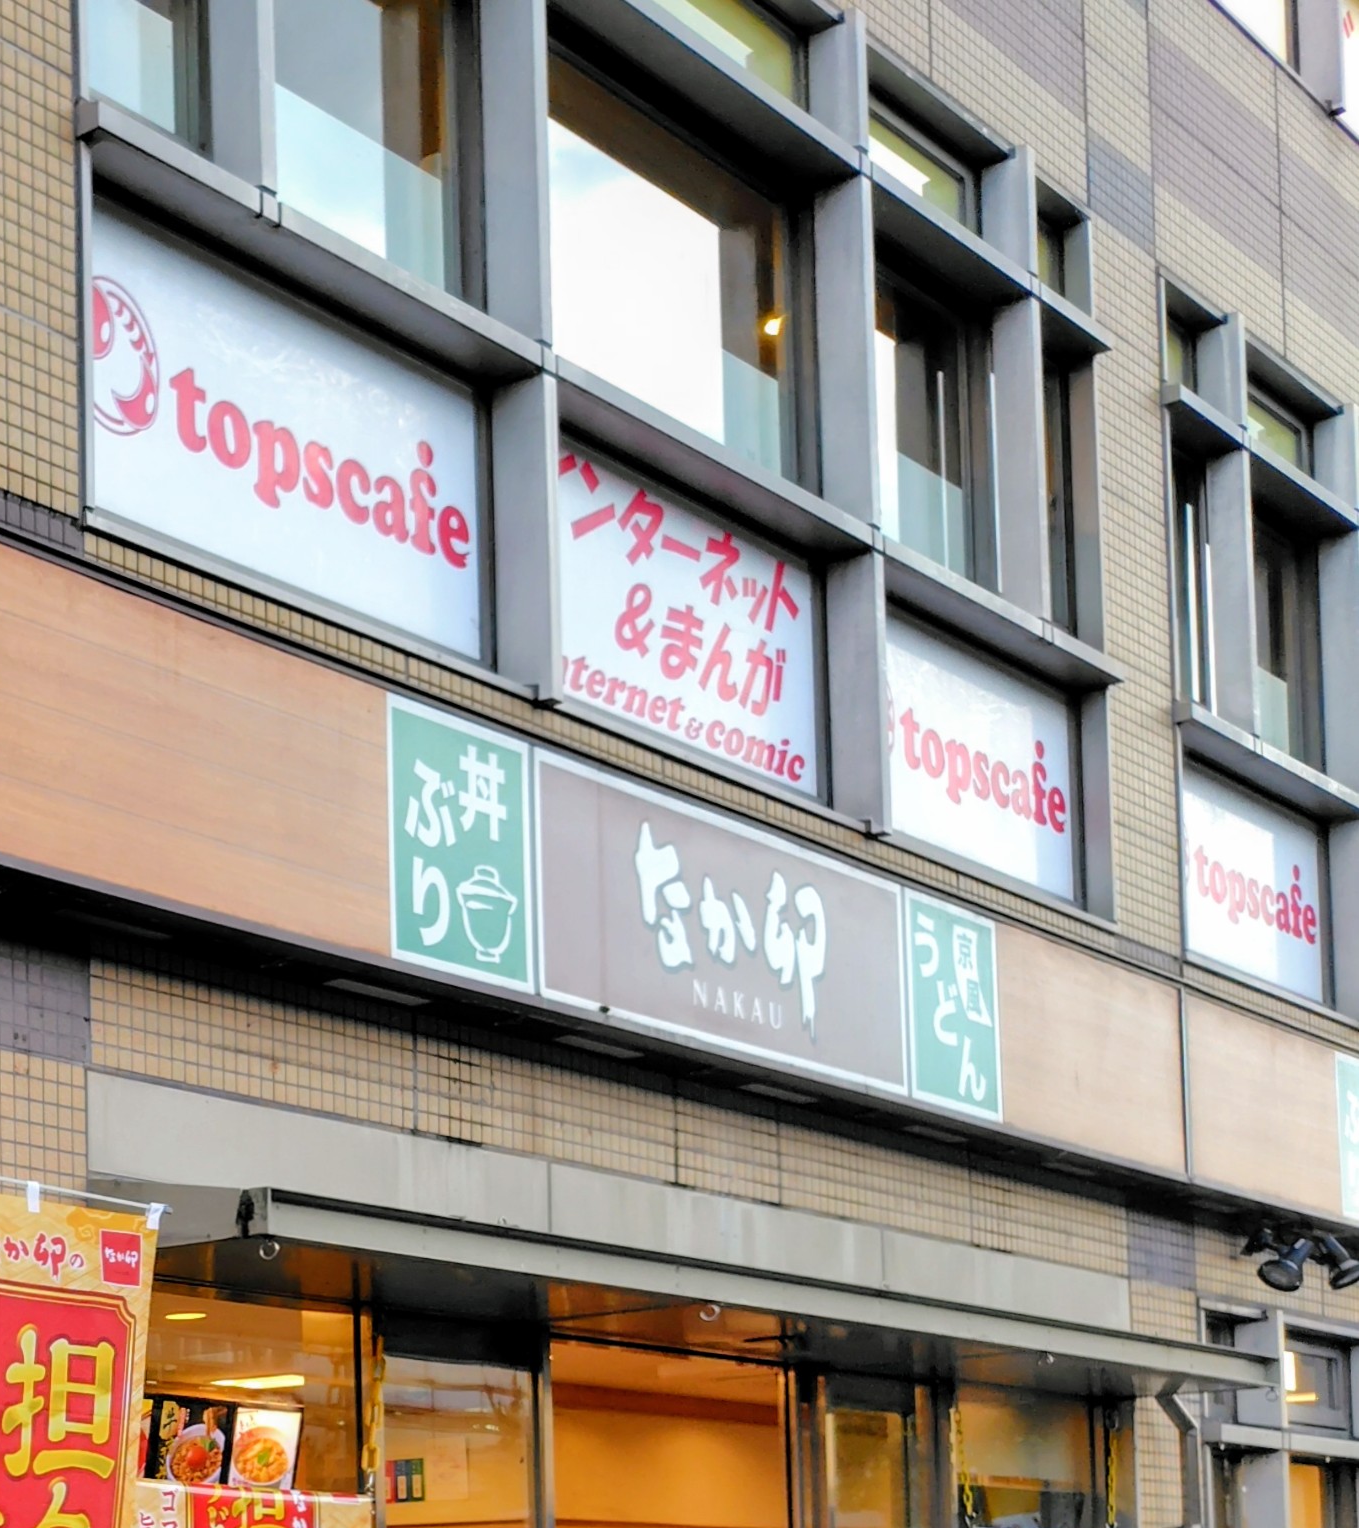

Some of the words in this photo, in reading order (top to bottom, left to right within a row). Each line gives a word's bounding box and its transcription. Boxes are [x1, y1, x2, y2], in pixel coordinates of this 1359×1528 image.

[615, 583, 786, 716] &まんが
[562, 655, 685, 732] ternet
[685, 717, 704, 741] &
[705, 720, 805, 782] comic
[634, 820, 827, 1040] なか卯
[693, 979, 783, 1030] NAKAU
[912, 911, 986, 1100] うどん
